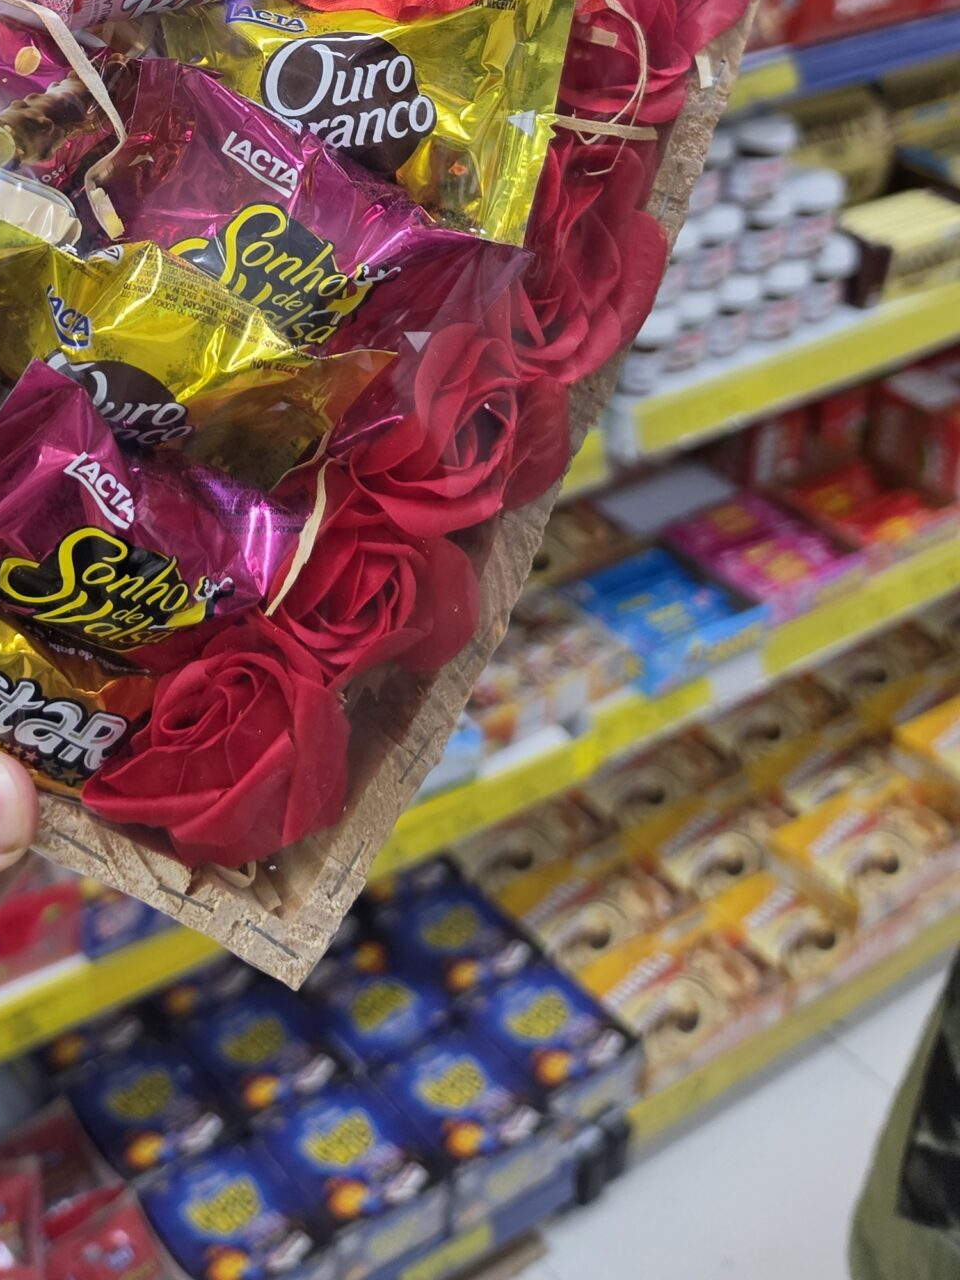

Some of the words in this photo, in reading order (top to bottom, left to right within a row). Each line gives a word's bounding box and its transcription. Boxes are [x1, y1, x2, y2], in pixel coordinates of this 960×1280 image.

[226, 2, 307, 32] LACTA
[265, 40, 413, 117] Ouro
[283, 94, 434, 149] ranco
[222, 131, 300, 190] LACTA
[168, 204, 348, 299] Sonho
[272, 285, 303, 311] de
[64, 451, 139, 528] LACTA
[112, 605, 141, 626] de
